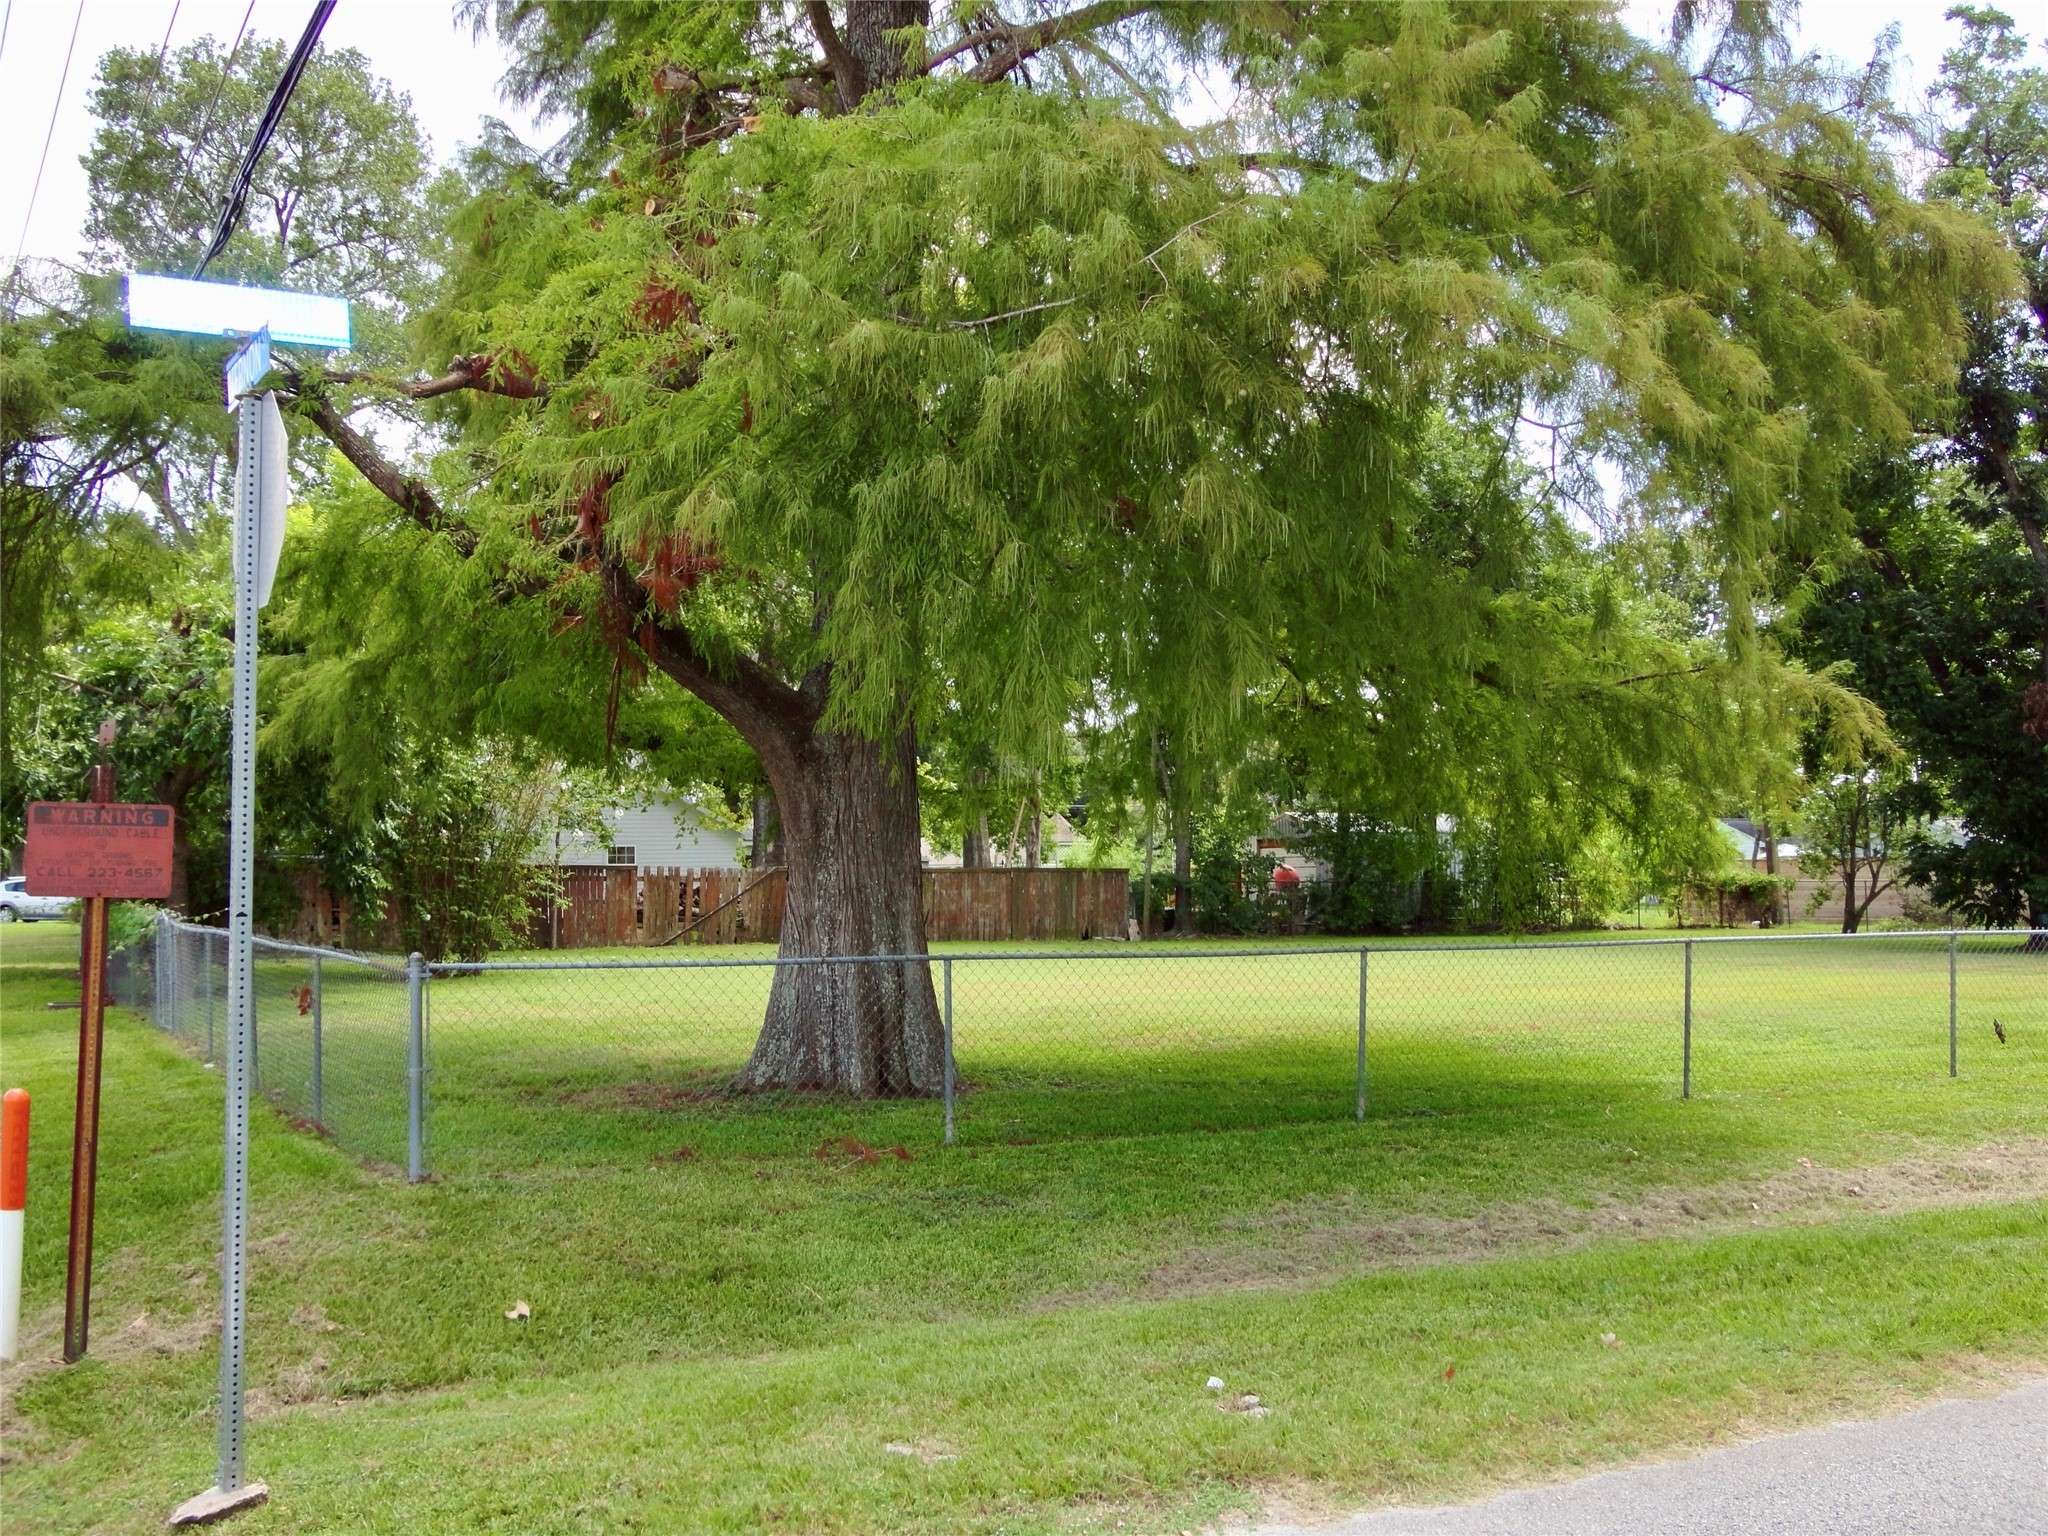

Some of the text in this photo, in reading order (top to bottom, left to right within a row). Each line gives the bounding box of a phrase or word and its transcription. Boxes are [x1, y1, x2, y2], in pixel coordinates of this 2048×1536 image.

[51, 808, 154, 825] WARNING
[126, 827, 159, 839] CABLE
[35, 867, 163, 879] CALL 223-4567
